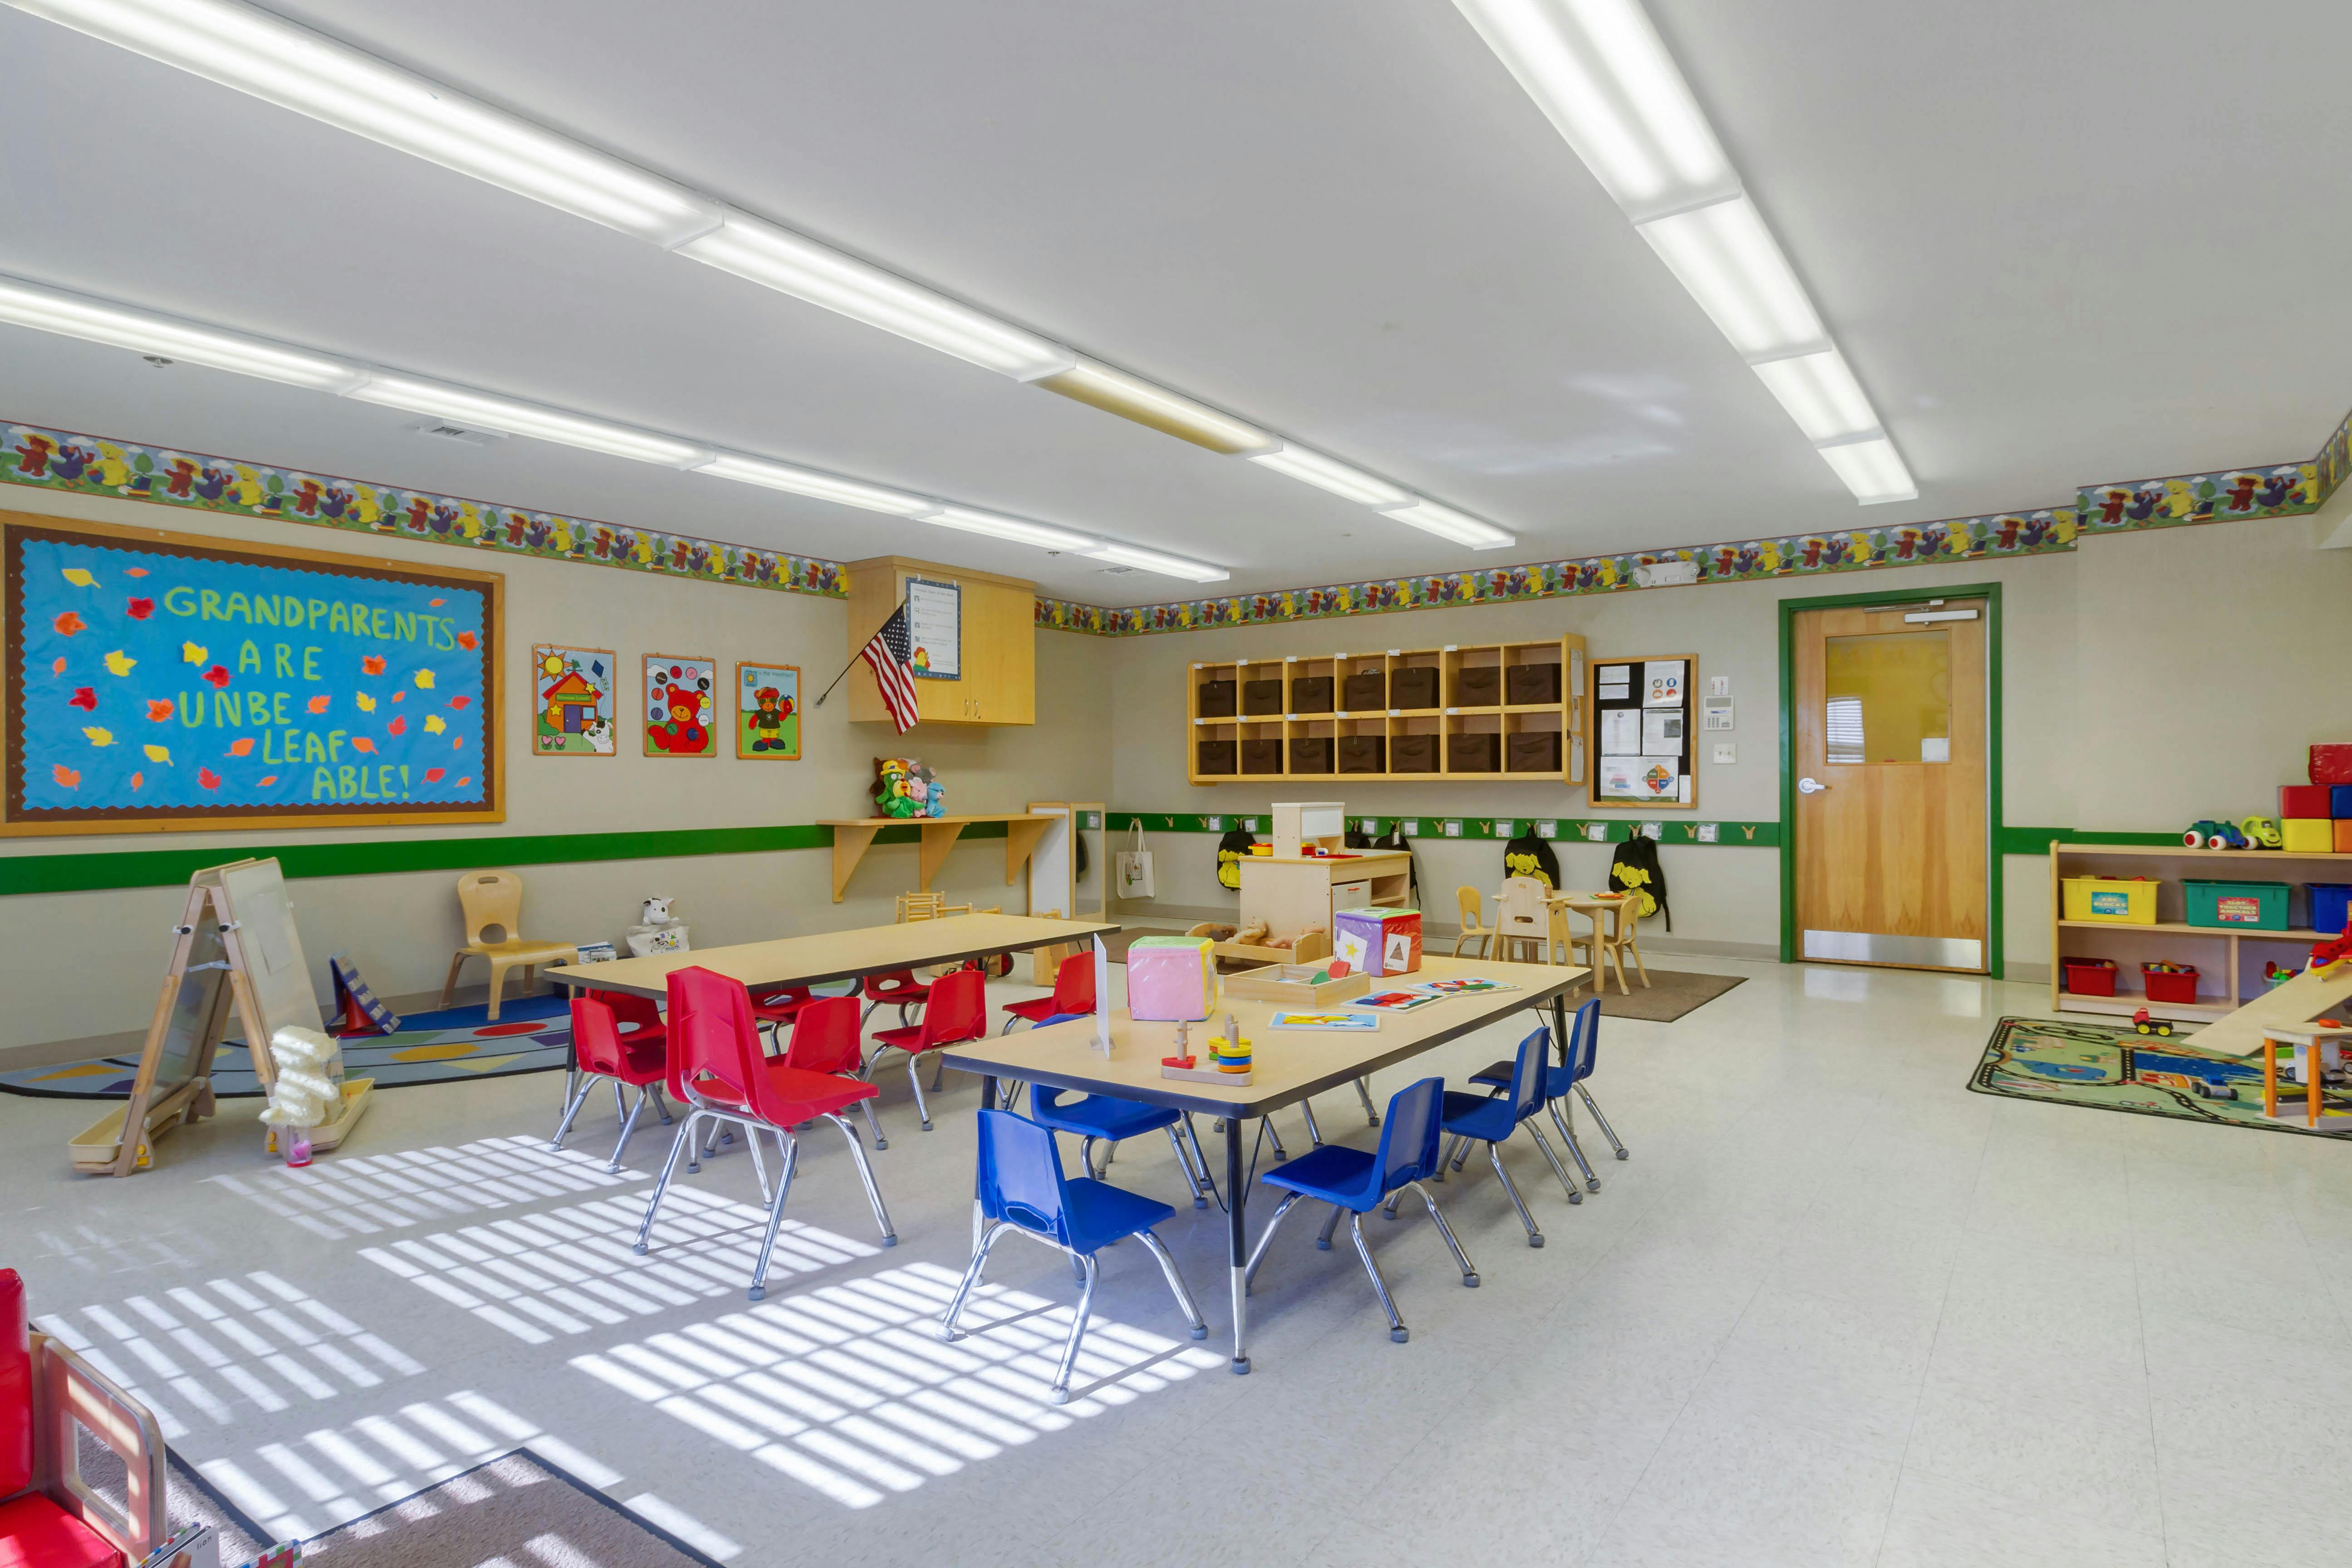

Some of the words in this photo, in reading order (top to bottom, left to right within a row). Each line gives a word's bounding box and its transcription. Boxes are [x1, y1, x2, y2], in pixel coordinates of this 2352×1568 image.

[164, 587, 455, 651] GRANDPARENTS
[239, 639, 323, 681] ARE
[179, 691, 291, 728] UNBE
[263, 729, 347, 764] LEAF
[312, 765, 409, 799] ABLE!
[197, 1536, 211, 1550] lion
